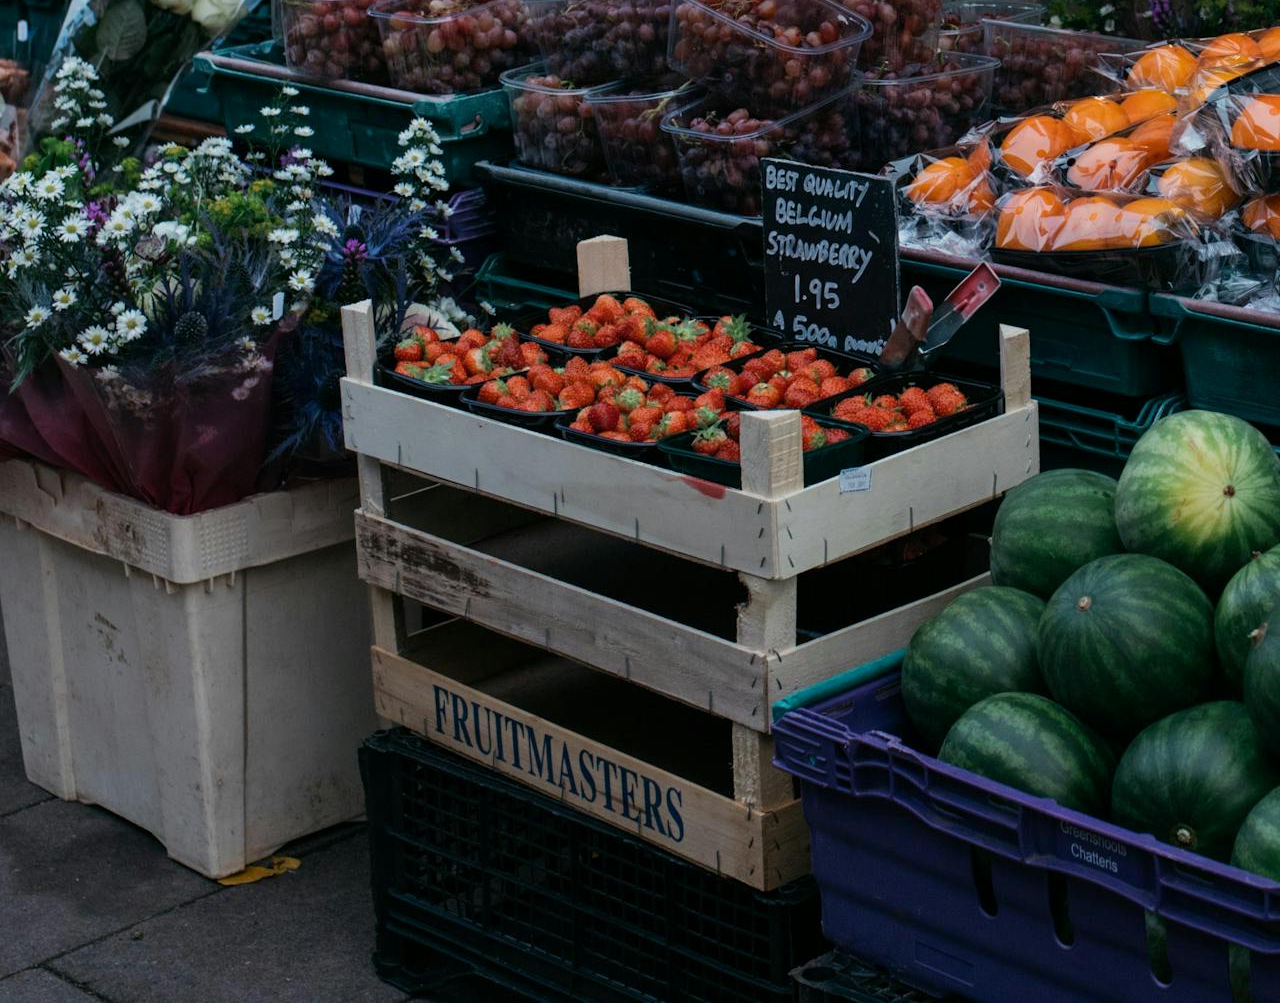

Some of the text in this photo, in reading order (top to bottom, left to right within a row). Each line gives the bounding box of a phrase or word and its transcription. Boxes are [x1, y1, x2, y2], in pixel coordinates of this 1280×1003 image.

[765, 164, 870, 208] BEST QUALITY
[775, 196, 853, 234] BELGIUM
[766, 230, 873, 284] STRAWBERRY
[794, 273, 840, 310] 1.95
[773, 309, 785, 331] A
[432, 684, 685, 843] FRUITMASTERS
[1070, 842, 1119, 874] Chatteris
